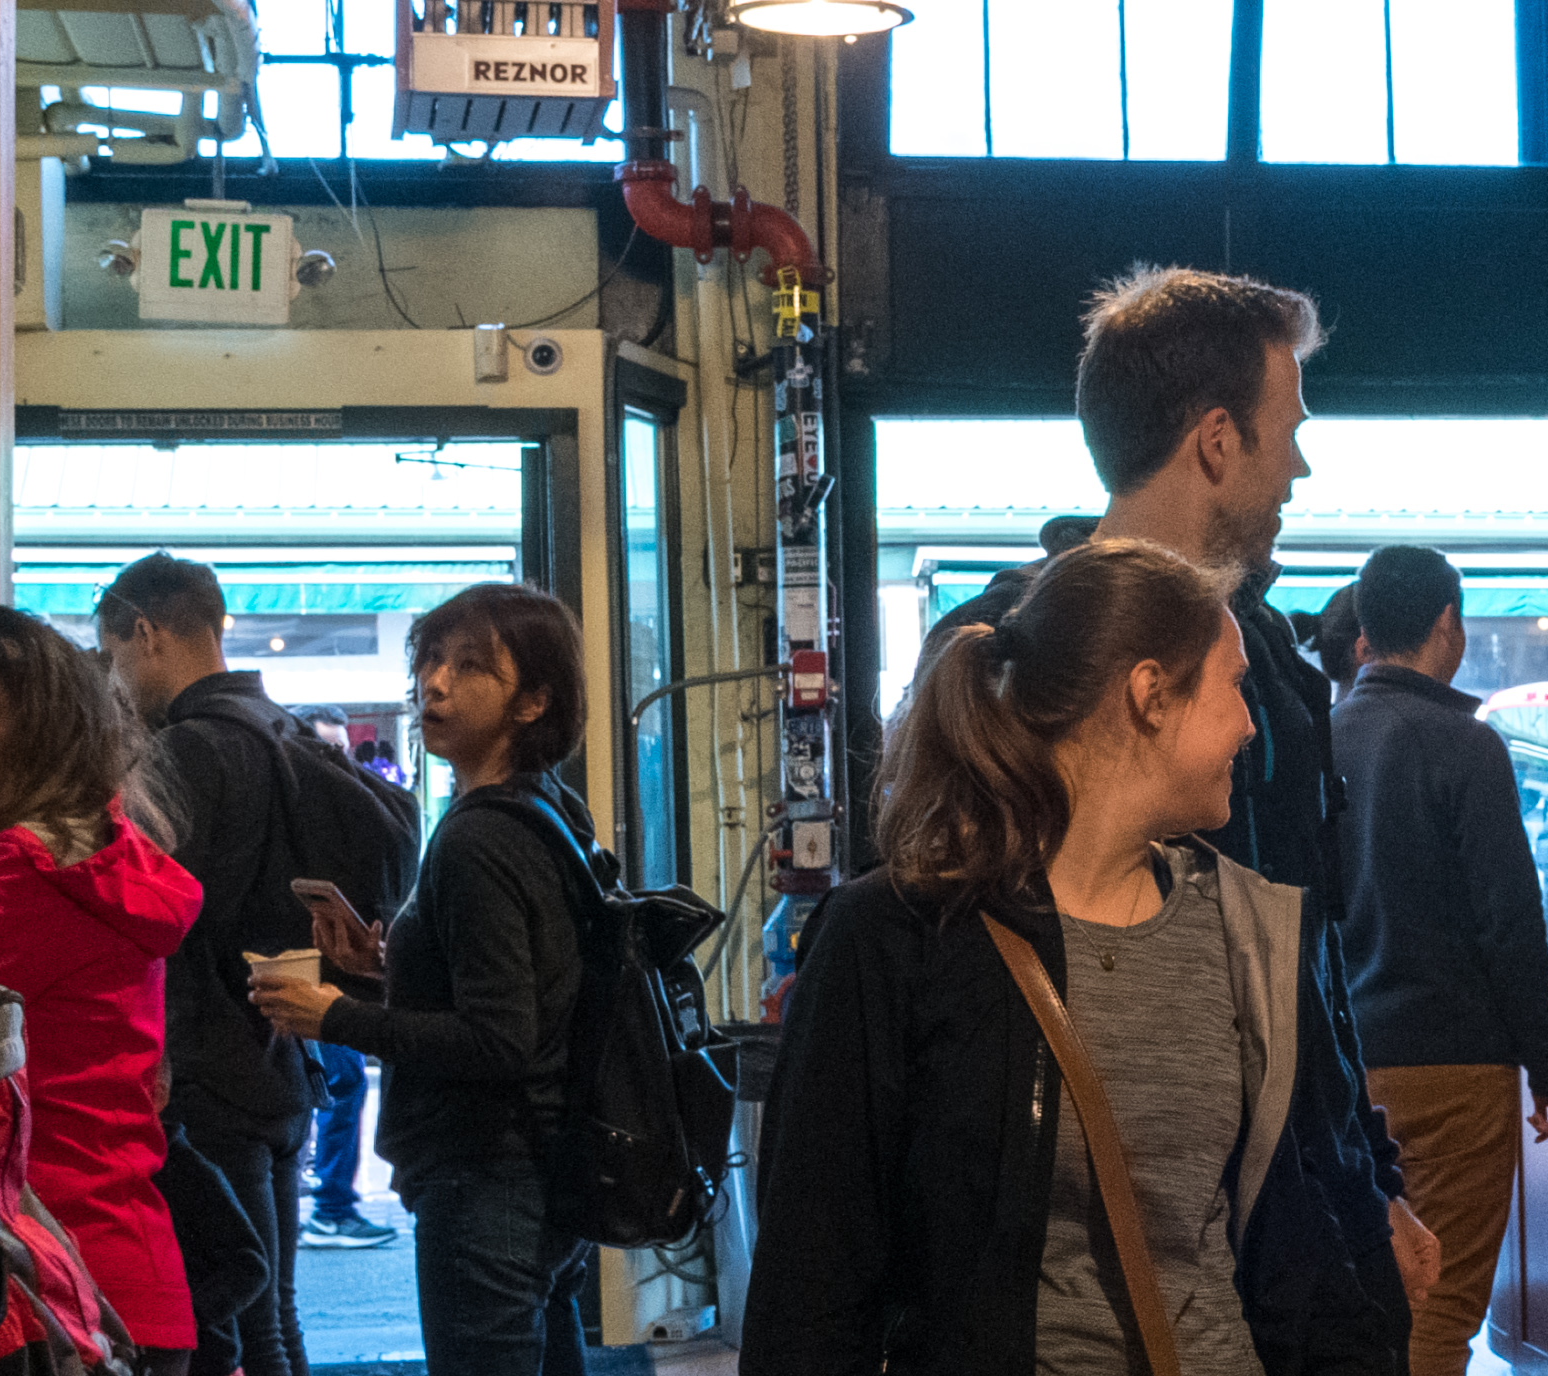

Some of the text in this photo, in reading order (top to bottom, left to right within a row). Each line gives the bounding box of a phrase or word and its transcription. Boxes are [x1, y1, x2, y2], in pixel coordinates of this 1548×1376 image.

[474, 59, 588, 85] REZNOR
[168, 220, 271, 292] EXIT
[803, 414, 817, 452] EYE
